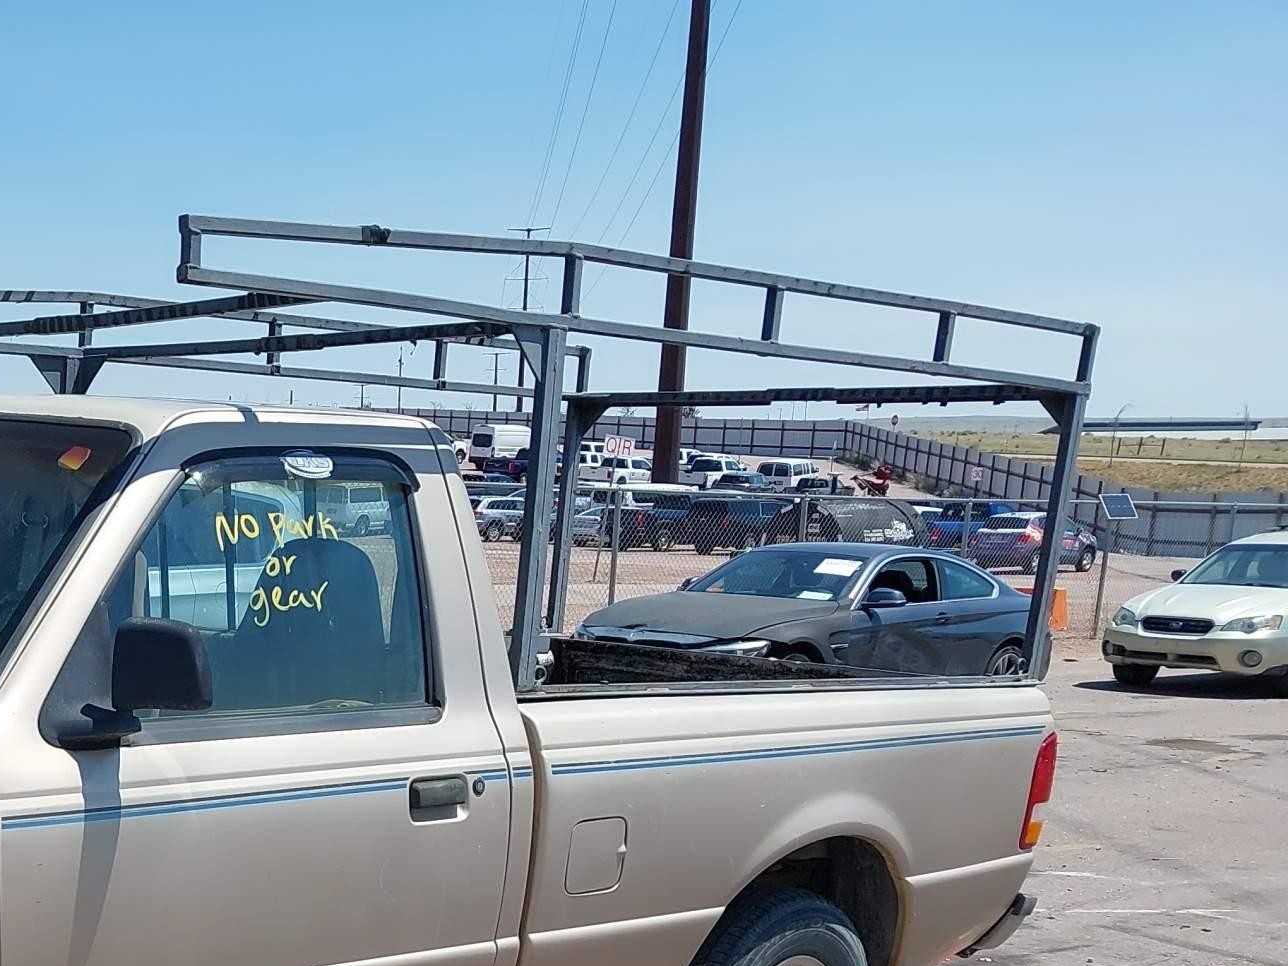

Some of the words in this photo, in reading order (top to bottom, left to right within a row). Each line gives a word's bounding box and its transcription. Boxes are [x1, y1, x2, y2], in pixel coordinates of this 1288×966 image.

[606, 437, 617, 453] Q
[622, 439, 632, 456] R
[268, 511, 339, 549] Park
[265, 555, 297, 577] or
[249, 581, 329, 627] gear
